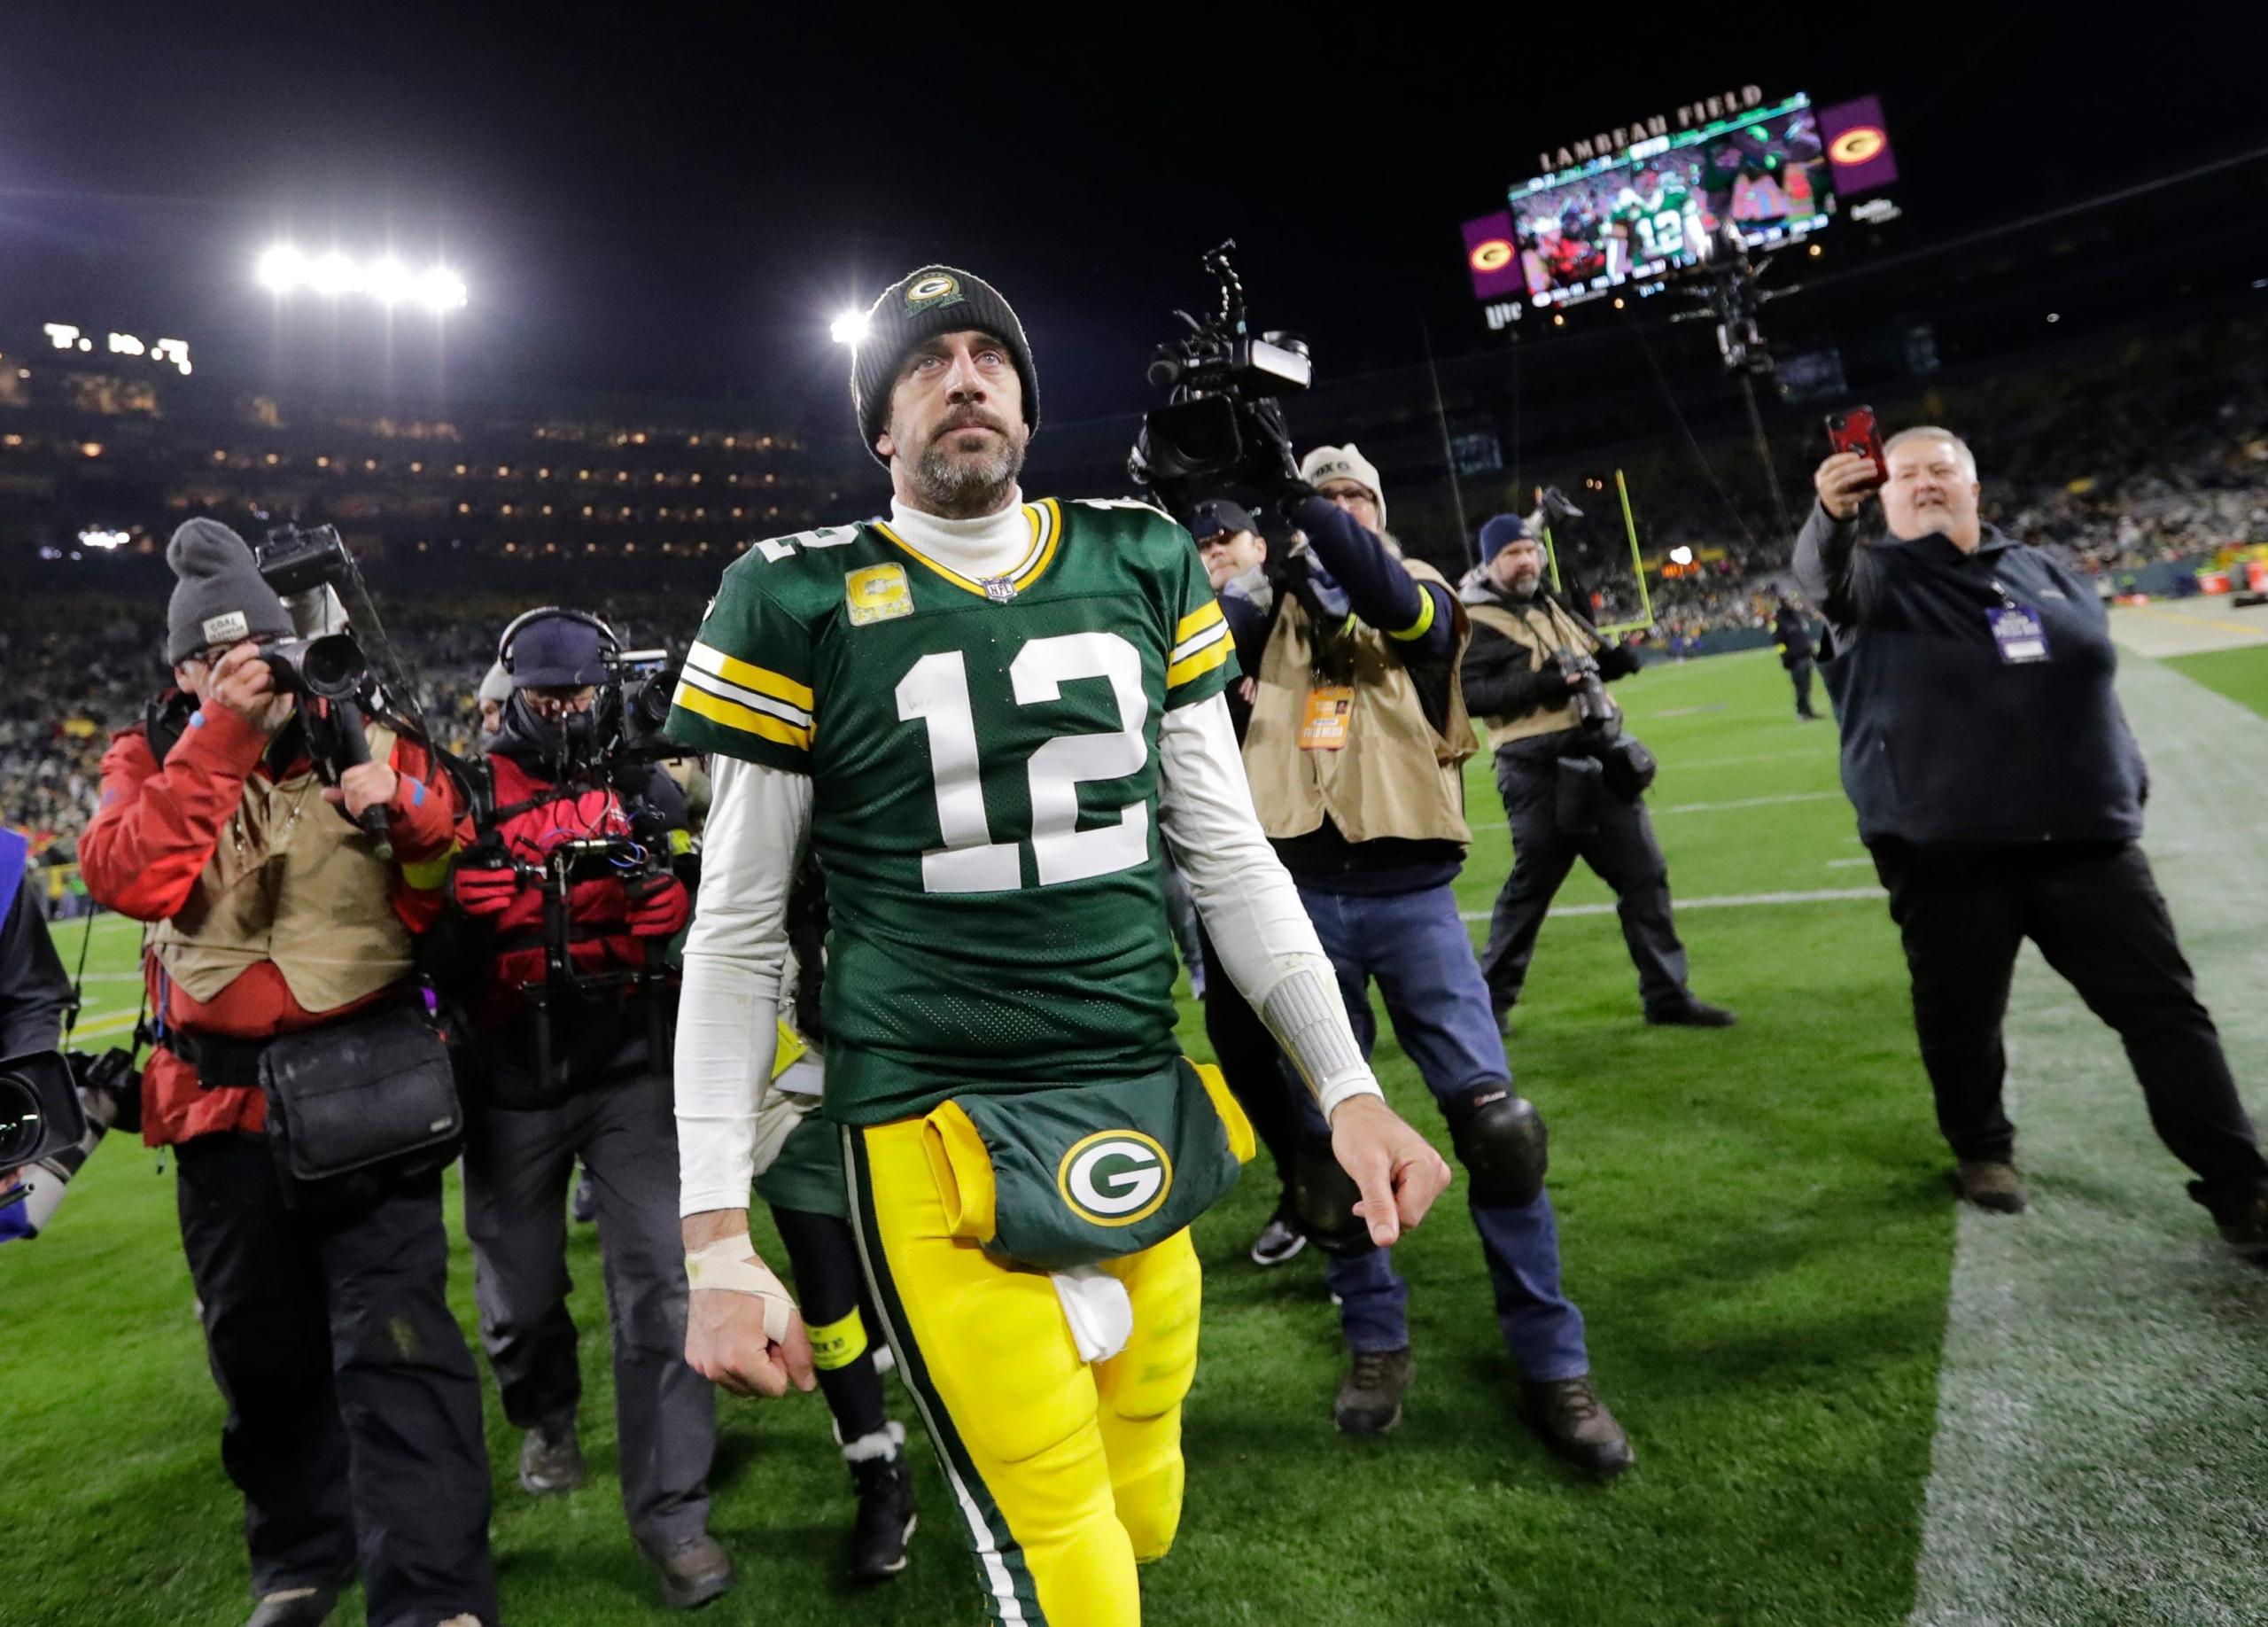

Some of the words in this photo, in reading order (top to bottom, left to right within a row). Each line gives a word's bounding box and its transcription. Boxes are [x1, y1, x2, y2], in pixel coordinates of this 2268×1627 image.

[1540, 113, 1667, 172] LAMBEAU
[1677, 84, 1762, 128] FIELD
[1635, 208, 1683, 255] 12
[849, 565, 905, 609] C
[990, 583, 1013, 596] NFL
[895, 632, 1149, 893] 12
[1069, 1141, 1162, 1213] G
